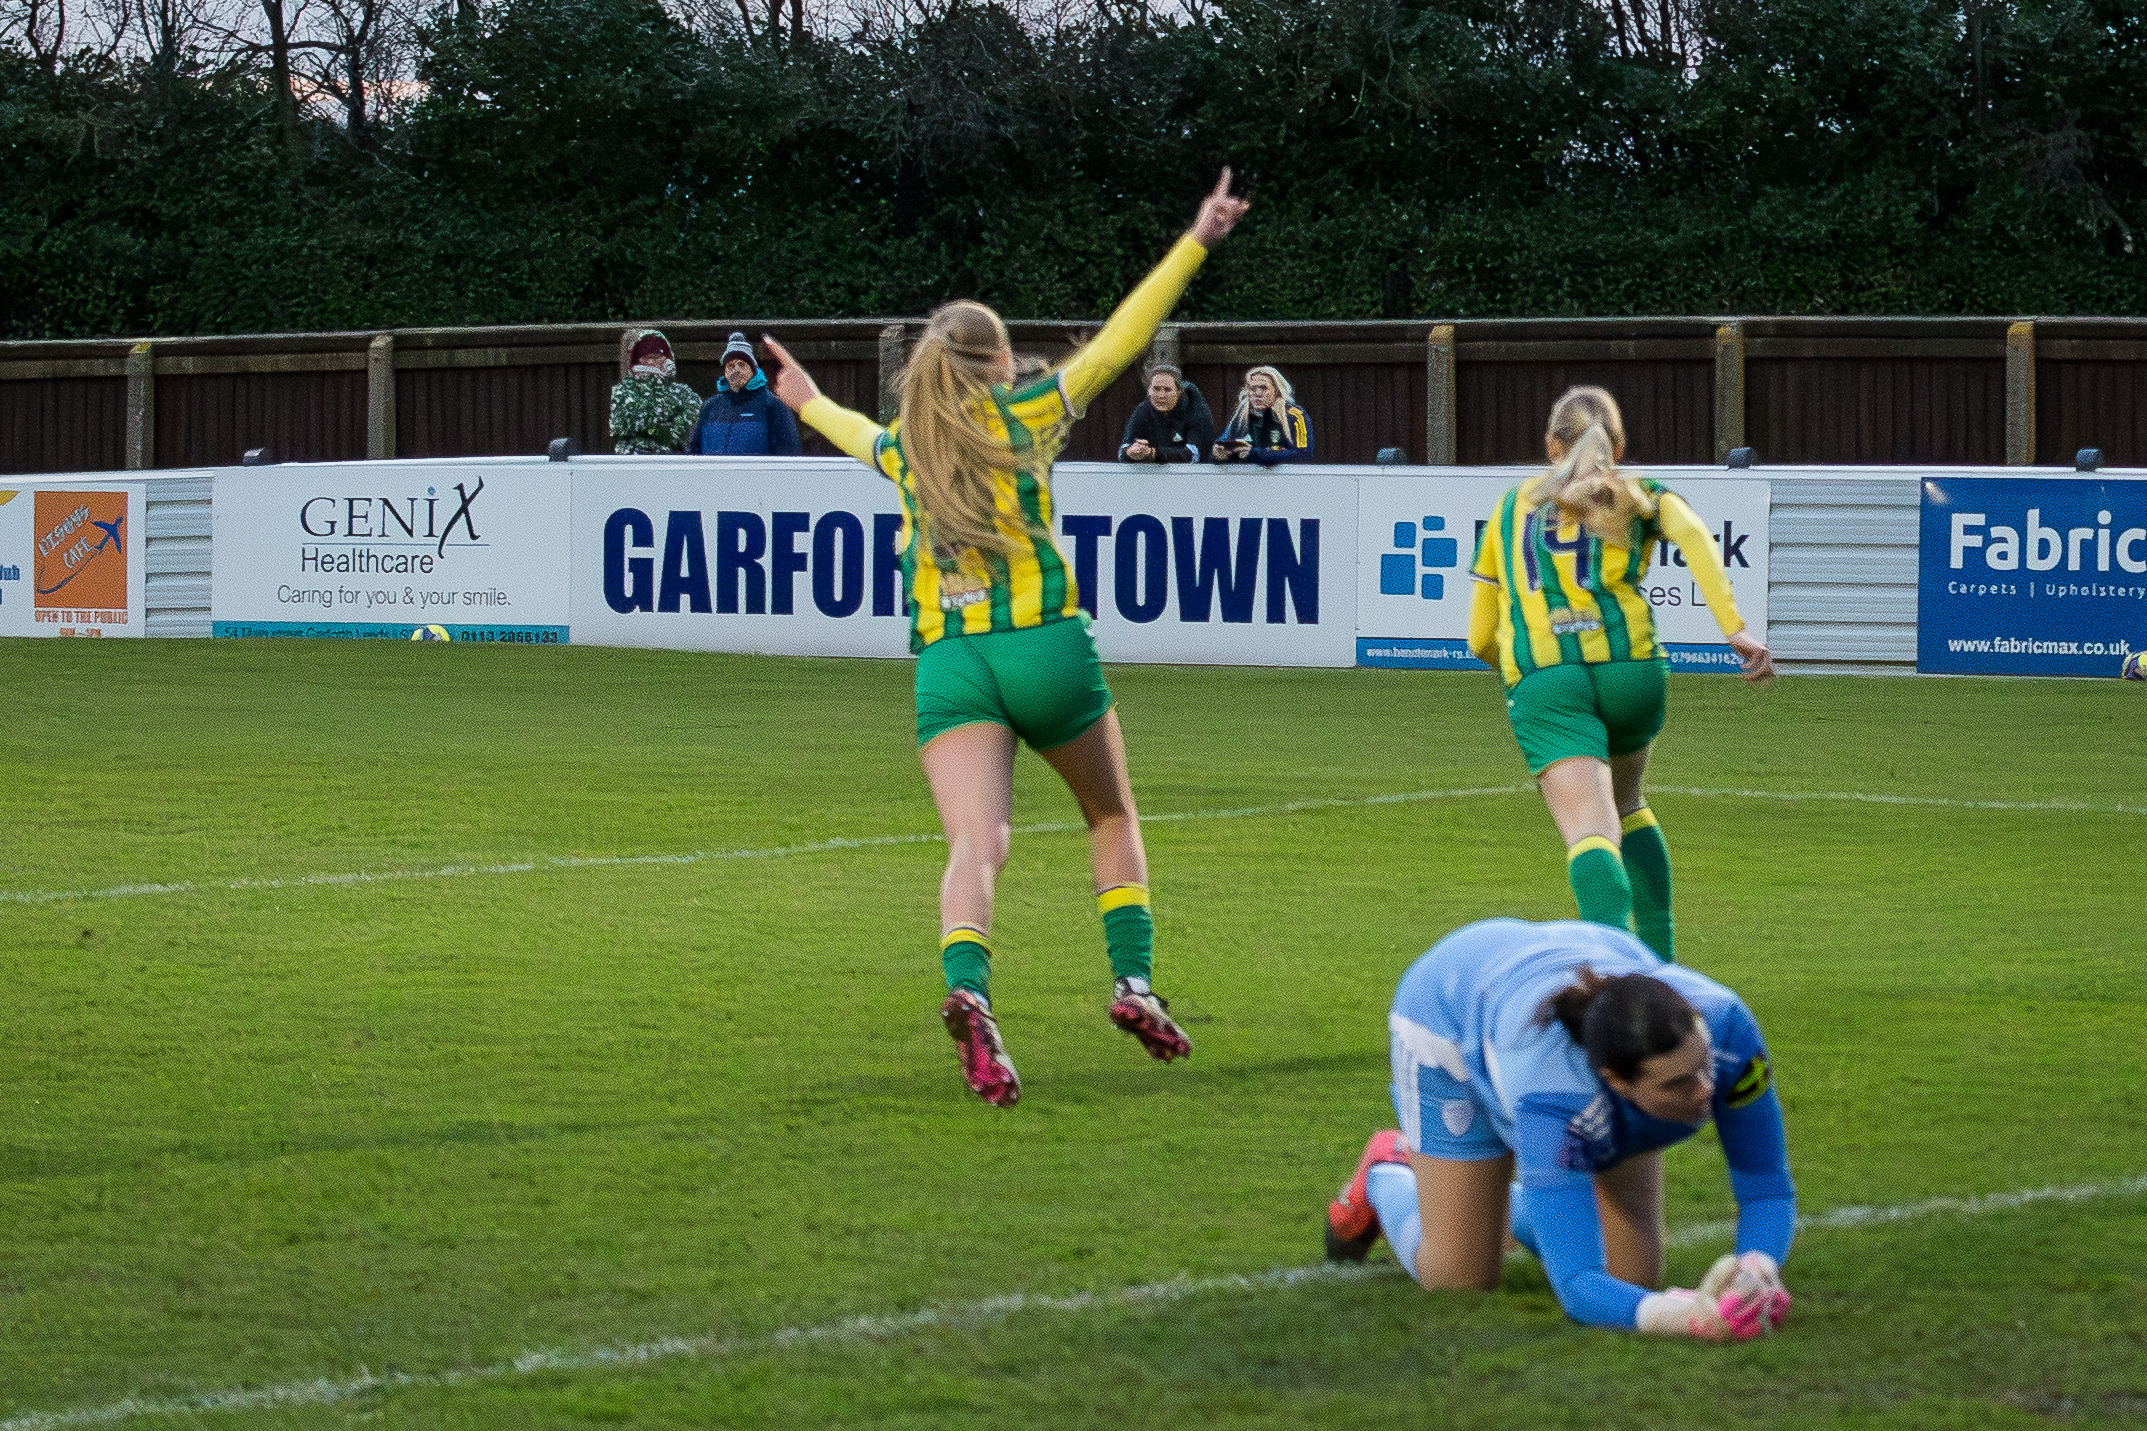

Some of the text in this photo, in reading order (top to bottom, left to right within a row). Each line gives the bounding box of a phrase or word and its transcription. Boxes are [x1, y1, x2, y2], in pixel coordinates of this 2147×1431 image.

[1521, 508, 1593, 593] 14
[1949, 508, 2147, 573] Fabric
[0, 564, 20, 581] lub
[301, 547, 435, 574] Healthcare
[603, 507, 1321, 625] GARFOR TOWN
[277, 584, 512, 609] Caring for you & your smile.
[1948, 581, 2017, 596] Carpets
[2045, 583, 2147, 600] Upholstery
[34, 610, 128, 625] OPEN TO THE PUBLIC
[1948, 637, 2130, 656] www.fabricmax.co.uk
